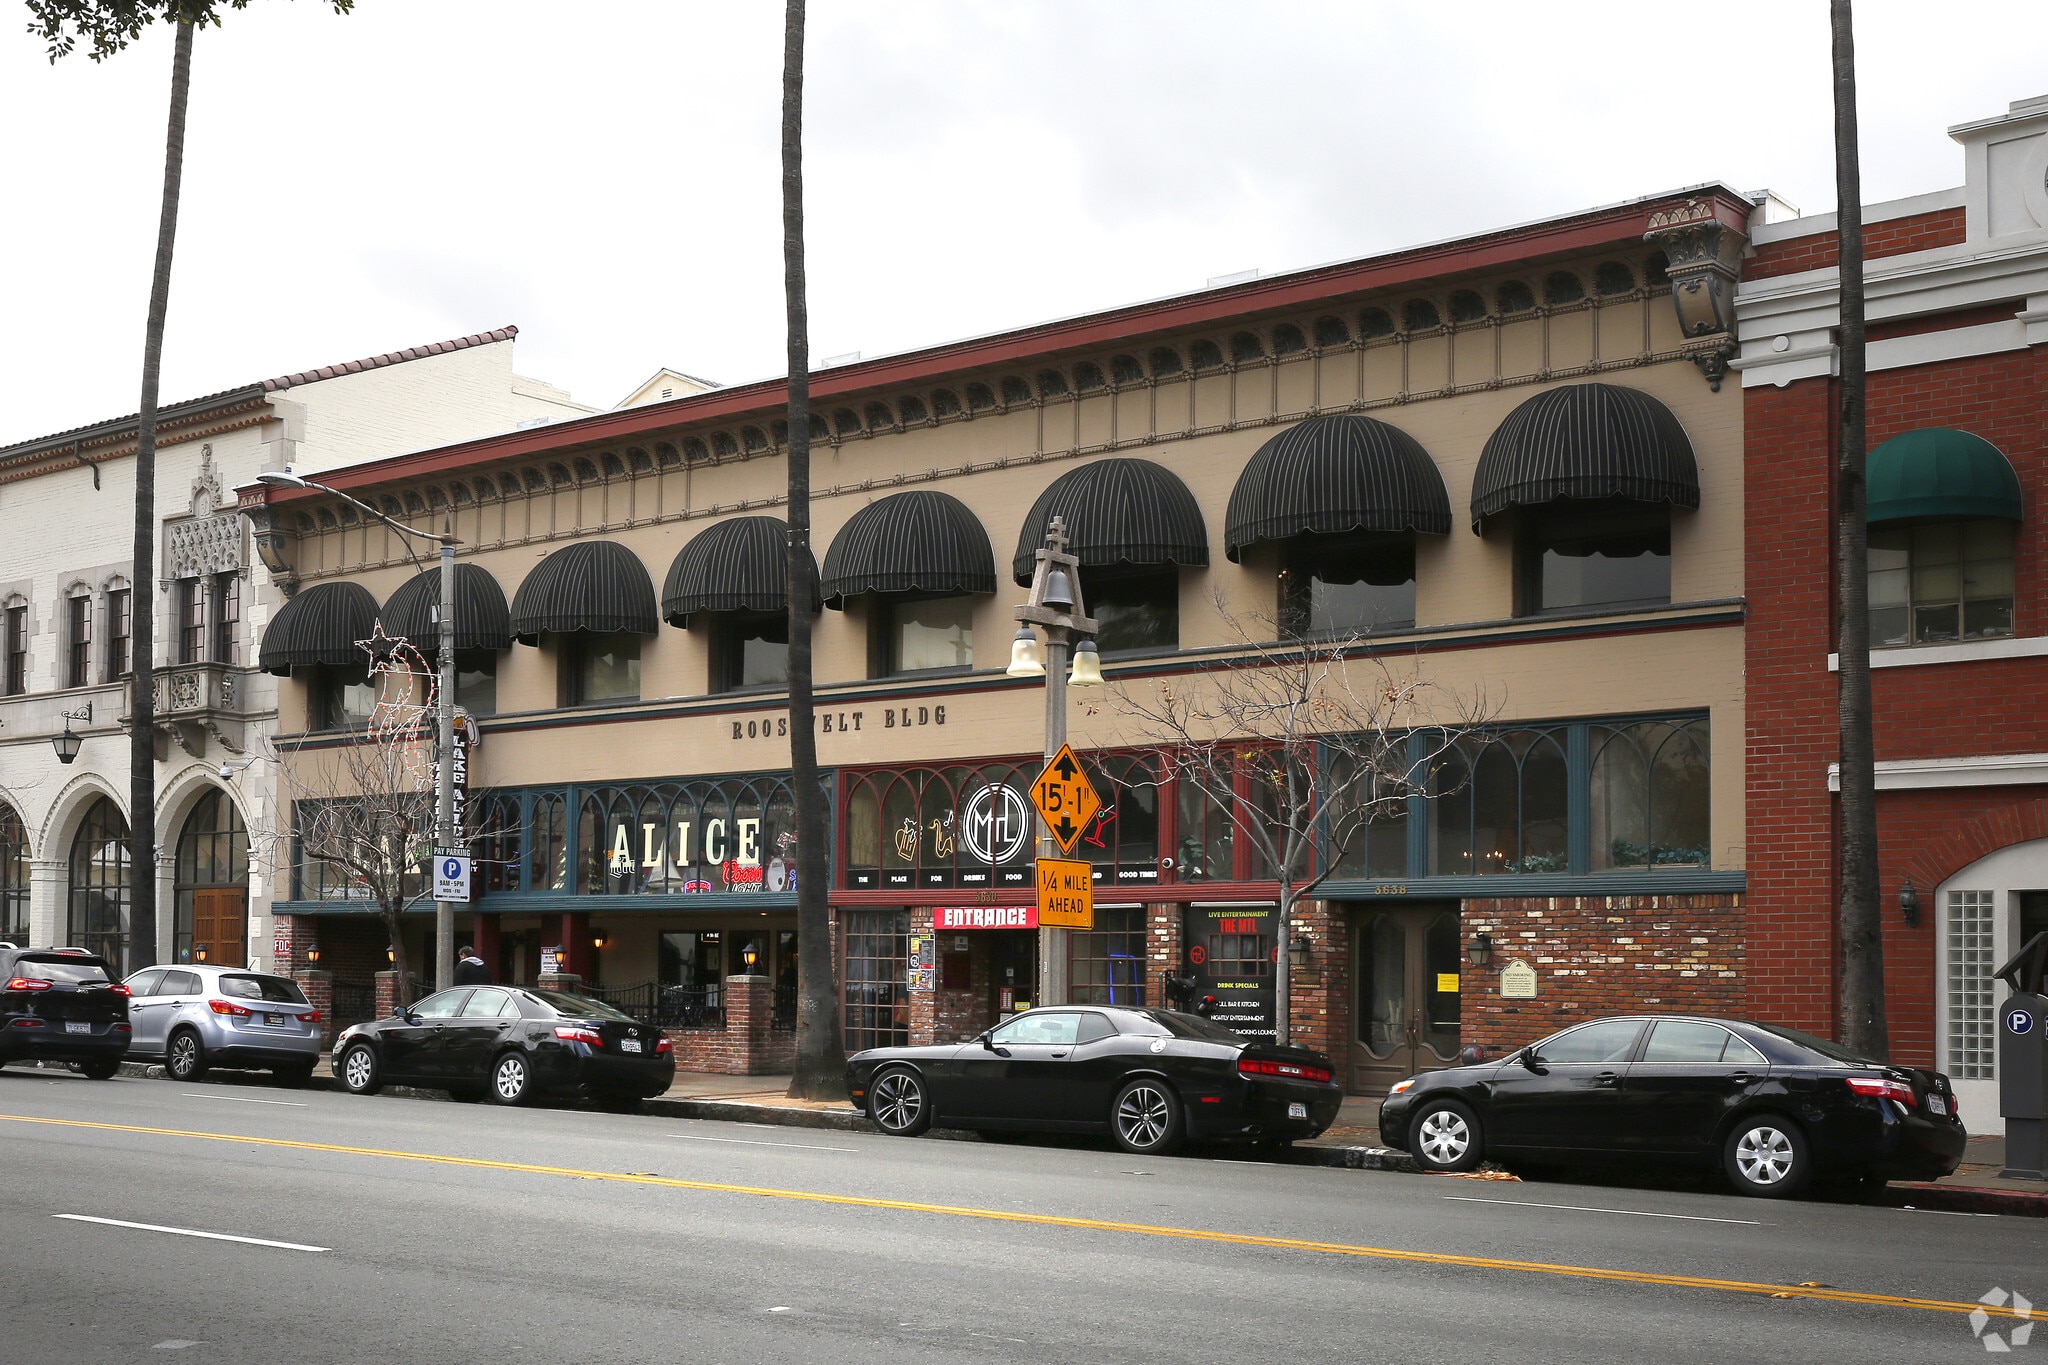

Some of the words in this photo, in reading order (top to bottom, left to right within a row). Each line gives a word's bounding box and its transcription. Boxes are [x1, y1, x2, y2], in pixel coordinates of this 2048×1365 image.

[732, 712, 863, 740] ROOSELT
[884, 705, 945, 728] BLDG
[612, 818, 761, 869] ALICE
[433, 847, 445, 855] PAY
[446, 848, 471, 857] PARKING
[448, 862, 457, 876] P
[722, 859, 763, 884] Coors
[1064, 875, 1088, 891] MILE
[1375, 885, 1407, 895] 3638
[1048, 897, 1084, 914] AHEAD
[944, 907, 1027, 927] ENTRANCE
[1220, 918, 1237, 933] THE
[1238, 918, 1257, 933] MTL
[274, 940, 290, 951] FDC
[2013, 1014, 2027, 1030] P
